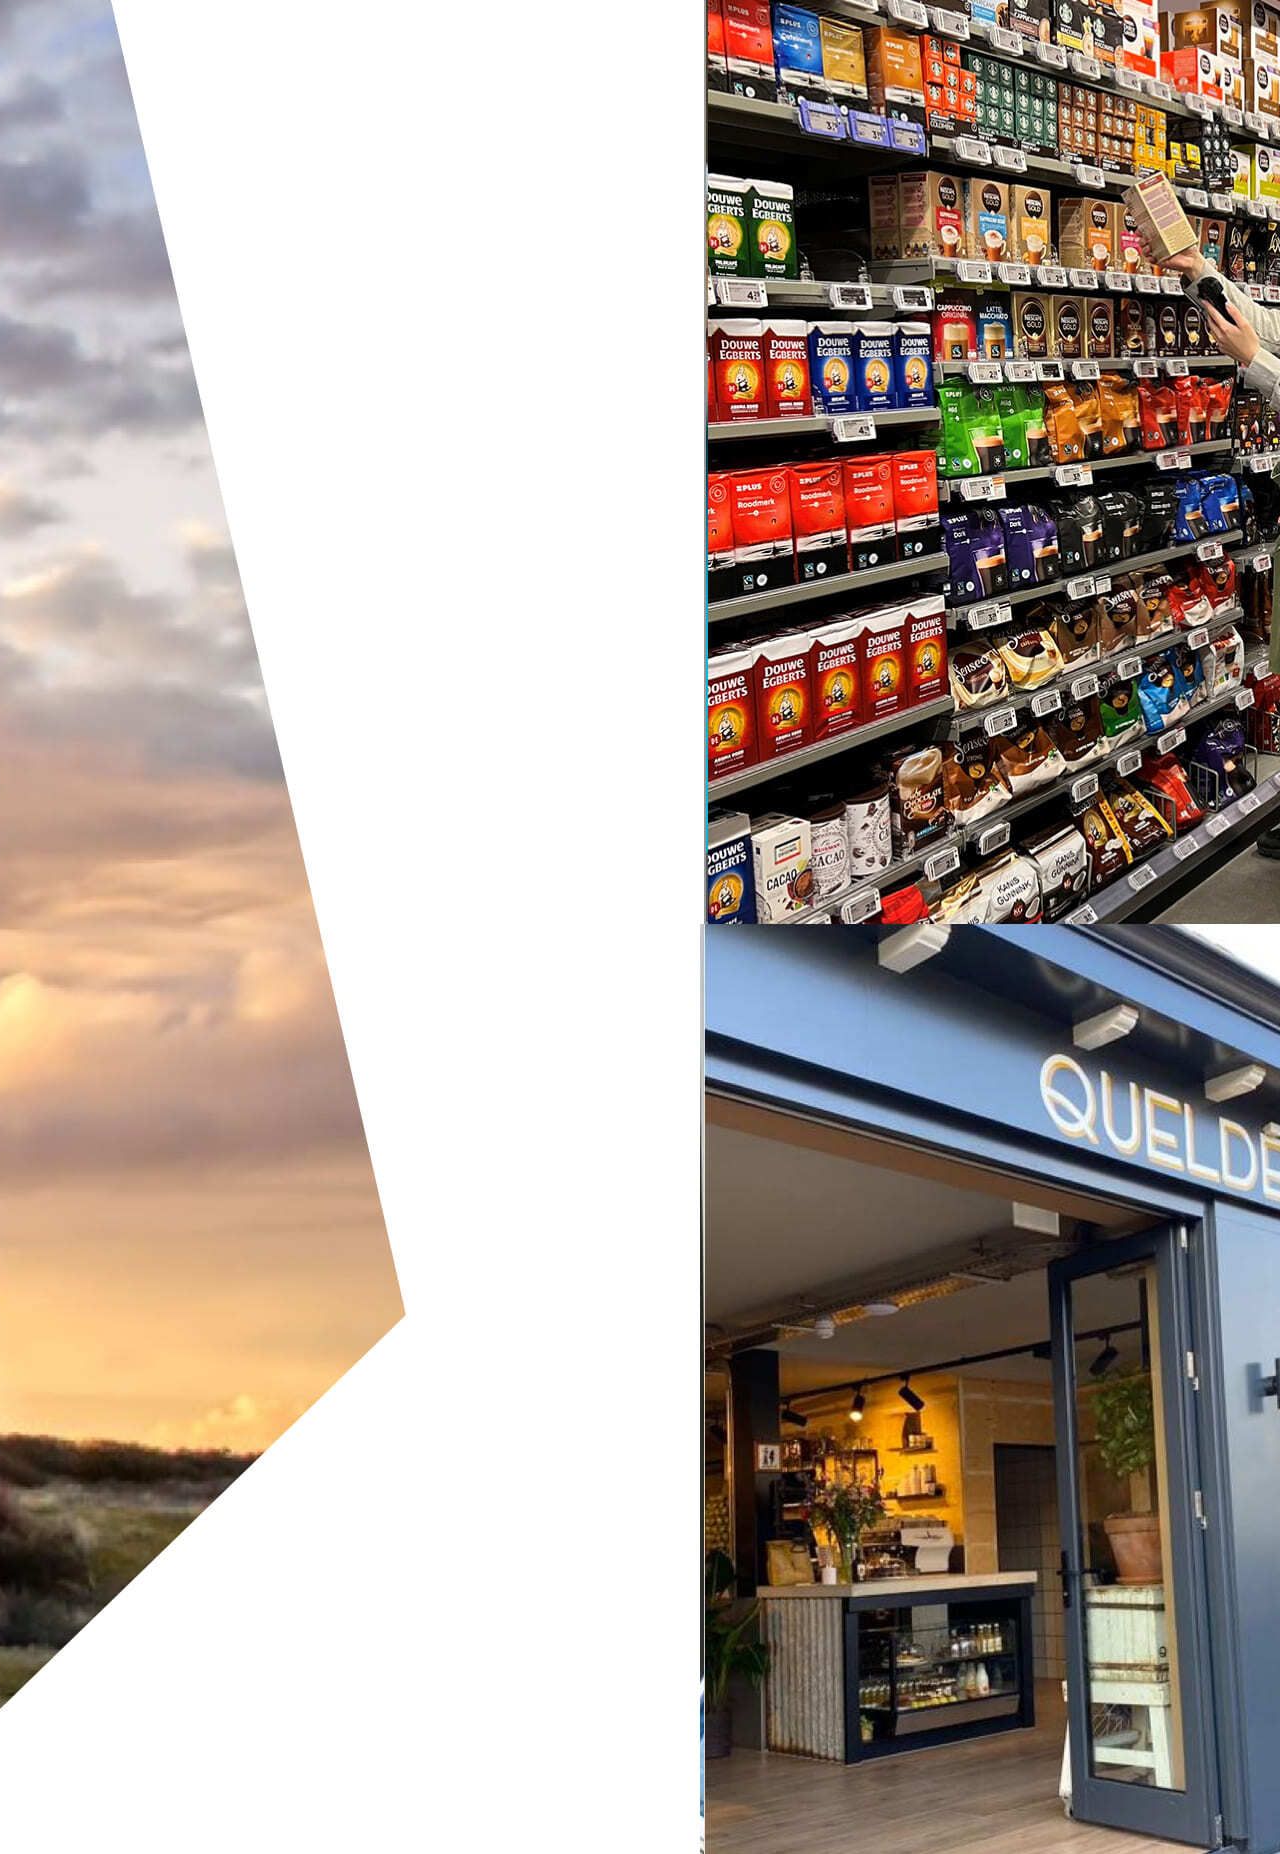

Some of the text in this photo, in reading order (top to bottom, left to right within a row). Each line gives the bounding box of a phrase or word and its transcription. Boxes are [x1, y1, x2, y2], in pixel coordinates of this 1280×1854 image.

[708, 204, 745, 217] GBERTS
[752, 208, 792, 223] EGBERTS
[720, 351, 761, 360] EGBERTS
[770, 350, 807, 360] EGBERTS
[817, 347, 851, 357] EGBERTS
[859, 349, 892, 358] EGBERTS
[900, 346, 930, 356] EGBERTS
[743, 483, 762, 492] PLUS
[737, 498, 775, 509] Roodmerk
[910, 627, 943, 643] EGBERTS
[866, 641, 902, 658] EGBERTS
[817, 654, 856, 672] EGBERTS
[762, 670, 806, 689] EGBERTS
[708, 686, 748, 706] GBERTS
[708, 852, 747, 876] GBERTS
[766, 868, 798, 891] CACAO
[997, 876, 1020, 893] KANIS
[996, 880, 1032, 906] GUNNINK
